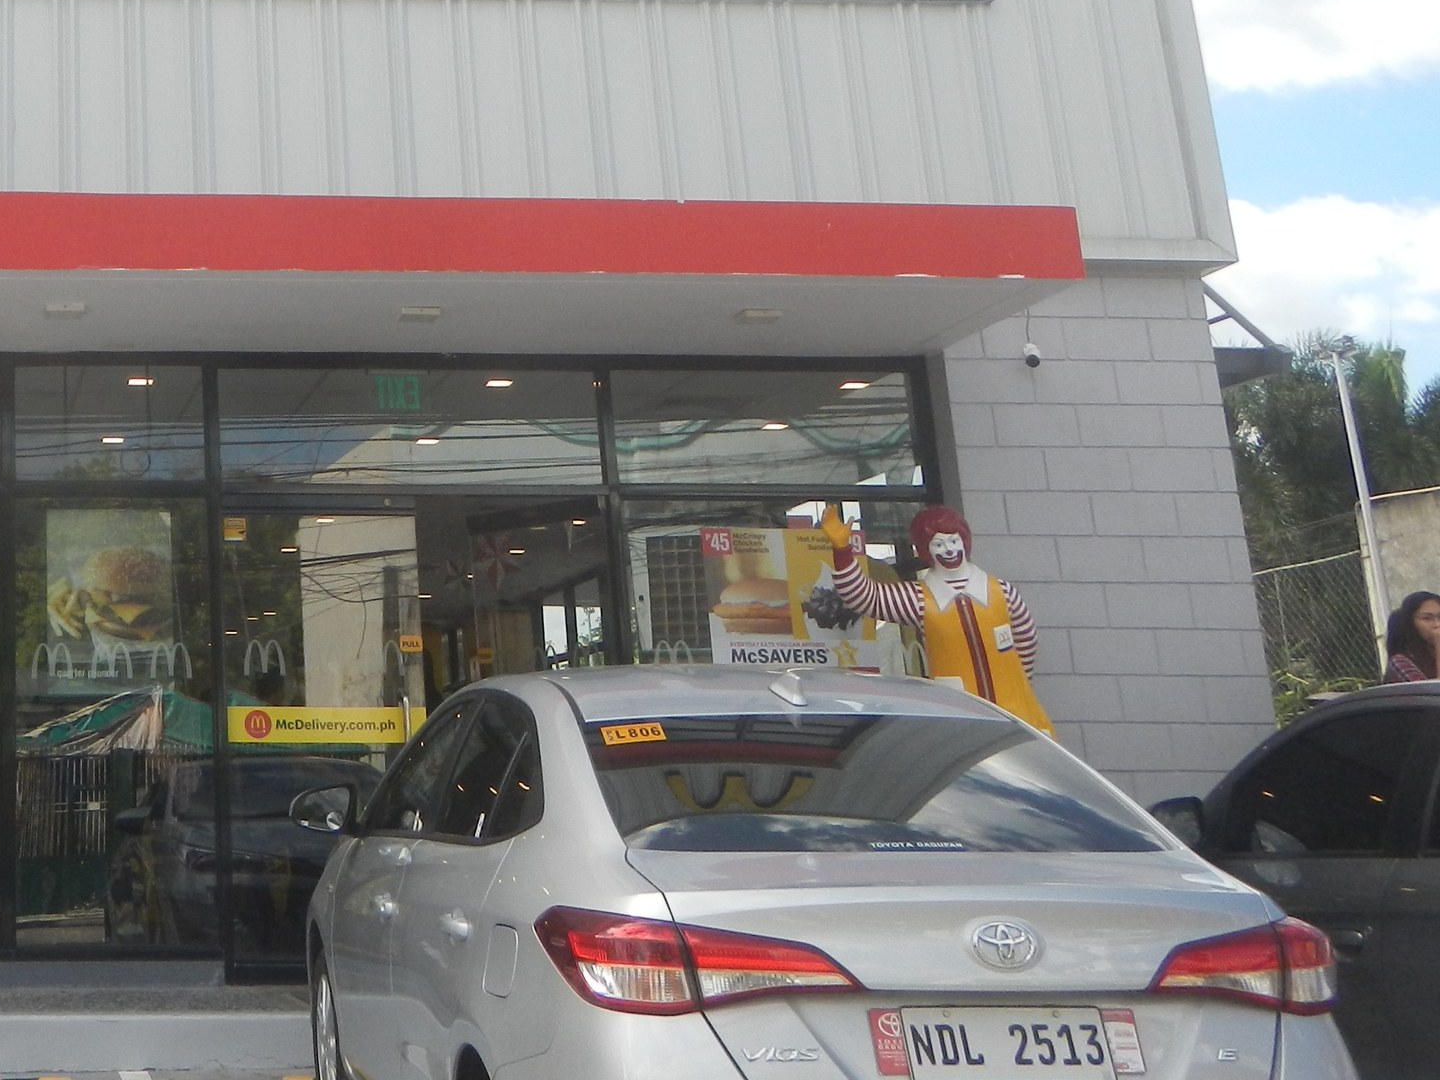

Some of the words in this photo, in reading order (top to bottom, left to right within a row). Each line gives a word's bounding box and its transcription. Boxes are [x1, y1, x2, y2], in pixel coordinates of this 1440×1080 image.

[401, 640, 421, 649] PULL
[731, 648, 828, 664] McSAVERS
[275, 719, 396, 733] McDelivery.com.ph
[910, 1024, 985, 1066] NDL
[1008, 1023, 1105, 1066] 2513
